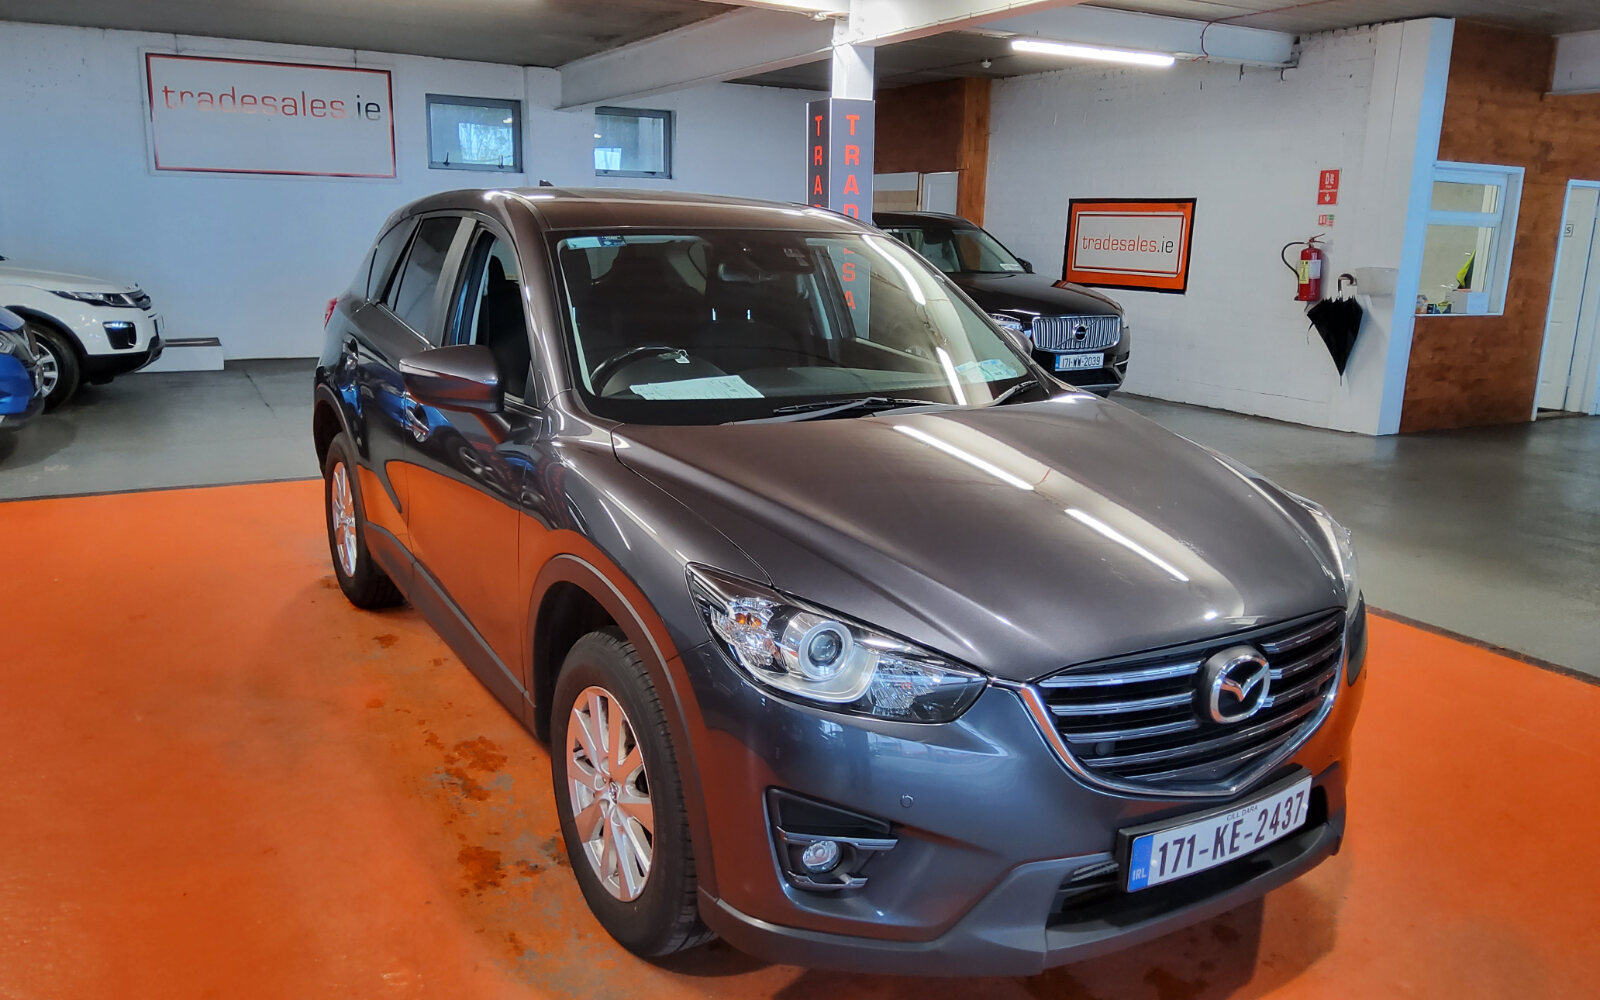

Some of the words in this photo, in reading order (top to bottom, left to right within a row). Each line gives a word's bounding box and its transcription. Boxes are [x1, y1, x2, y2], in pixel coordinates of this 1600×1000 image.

[162, 84, 381, 121] tradesalesie
[1082, 234, 1174, 253] tradesales.ie
[1227, 811, 1241, 821] CILL
[1241, 805, 1258, 816] DARA
[1158, 790, 1305, 877] 171-KE-2437
[1132, 867, 1147, 882] IRL
